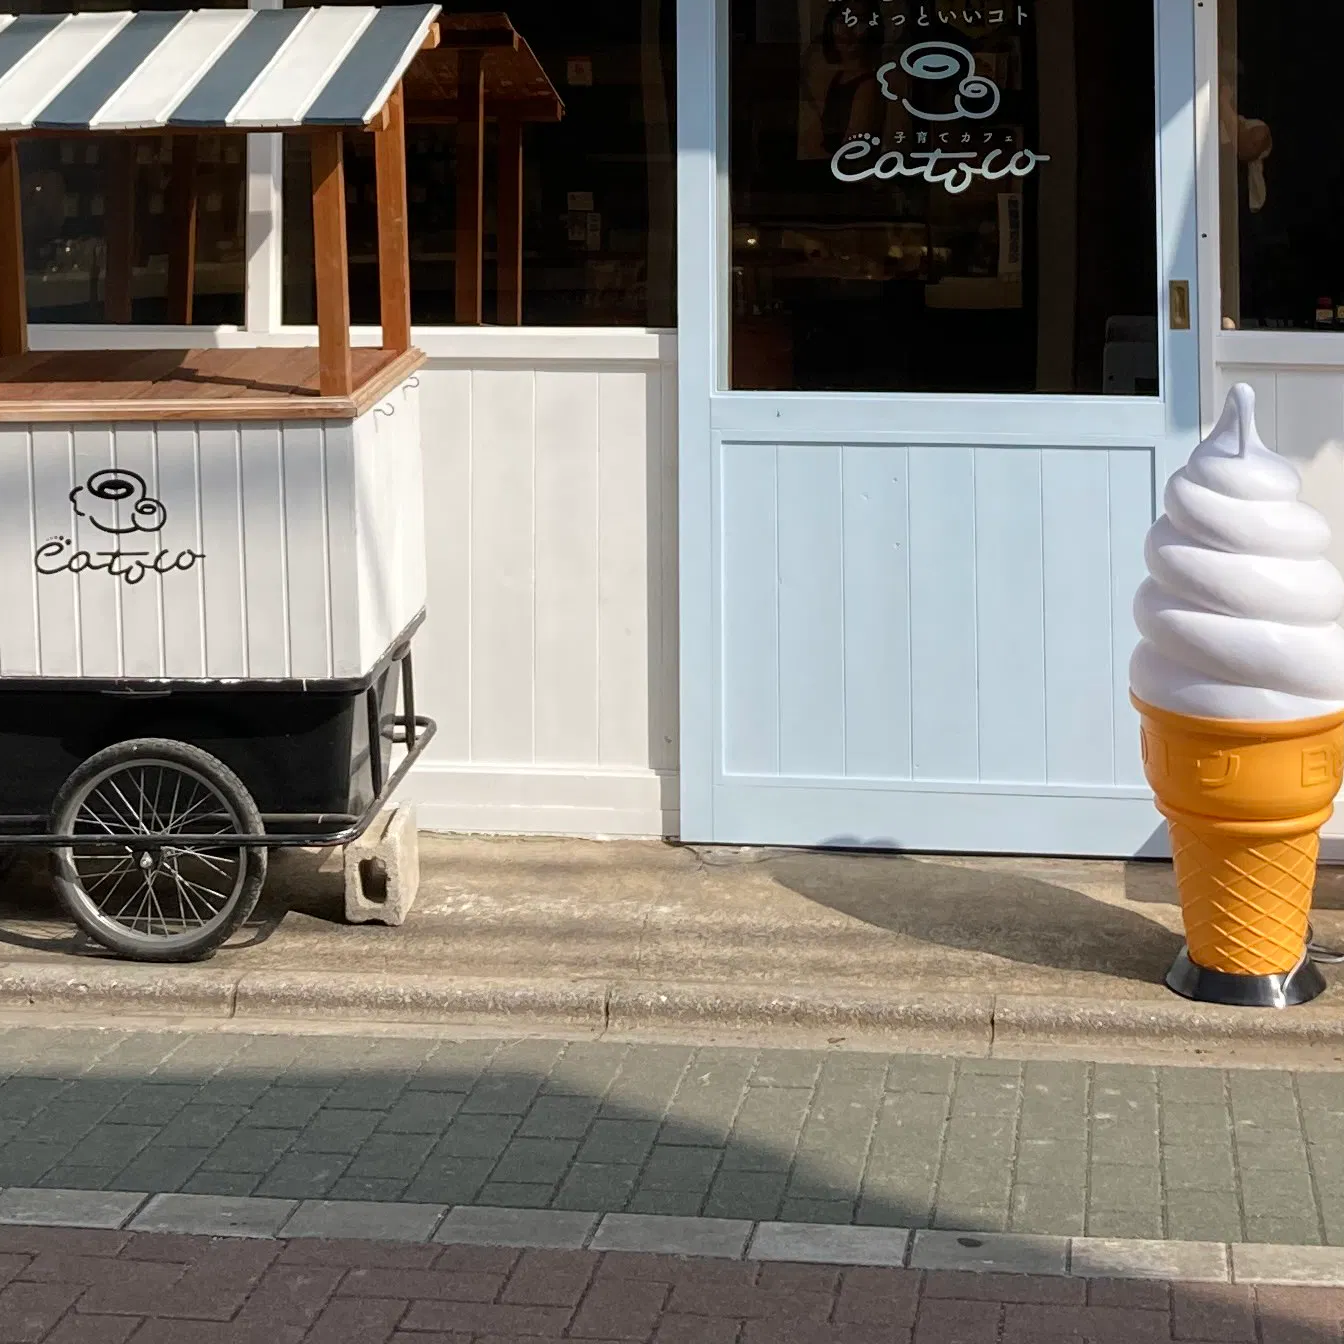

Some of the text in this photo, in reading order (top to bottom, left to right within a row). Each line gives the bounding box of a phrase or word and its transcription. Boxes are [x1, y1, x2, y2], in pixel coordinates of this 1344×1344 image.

[841, 6, 1028, 27] ちょっといいコト
[894, 131, 1013, 144] 子育てカフェ
